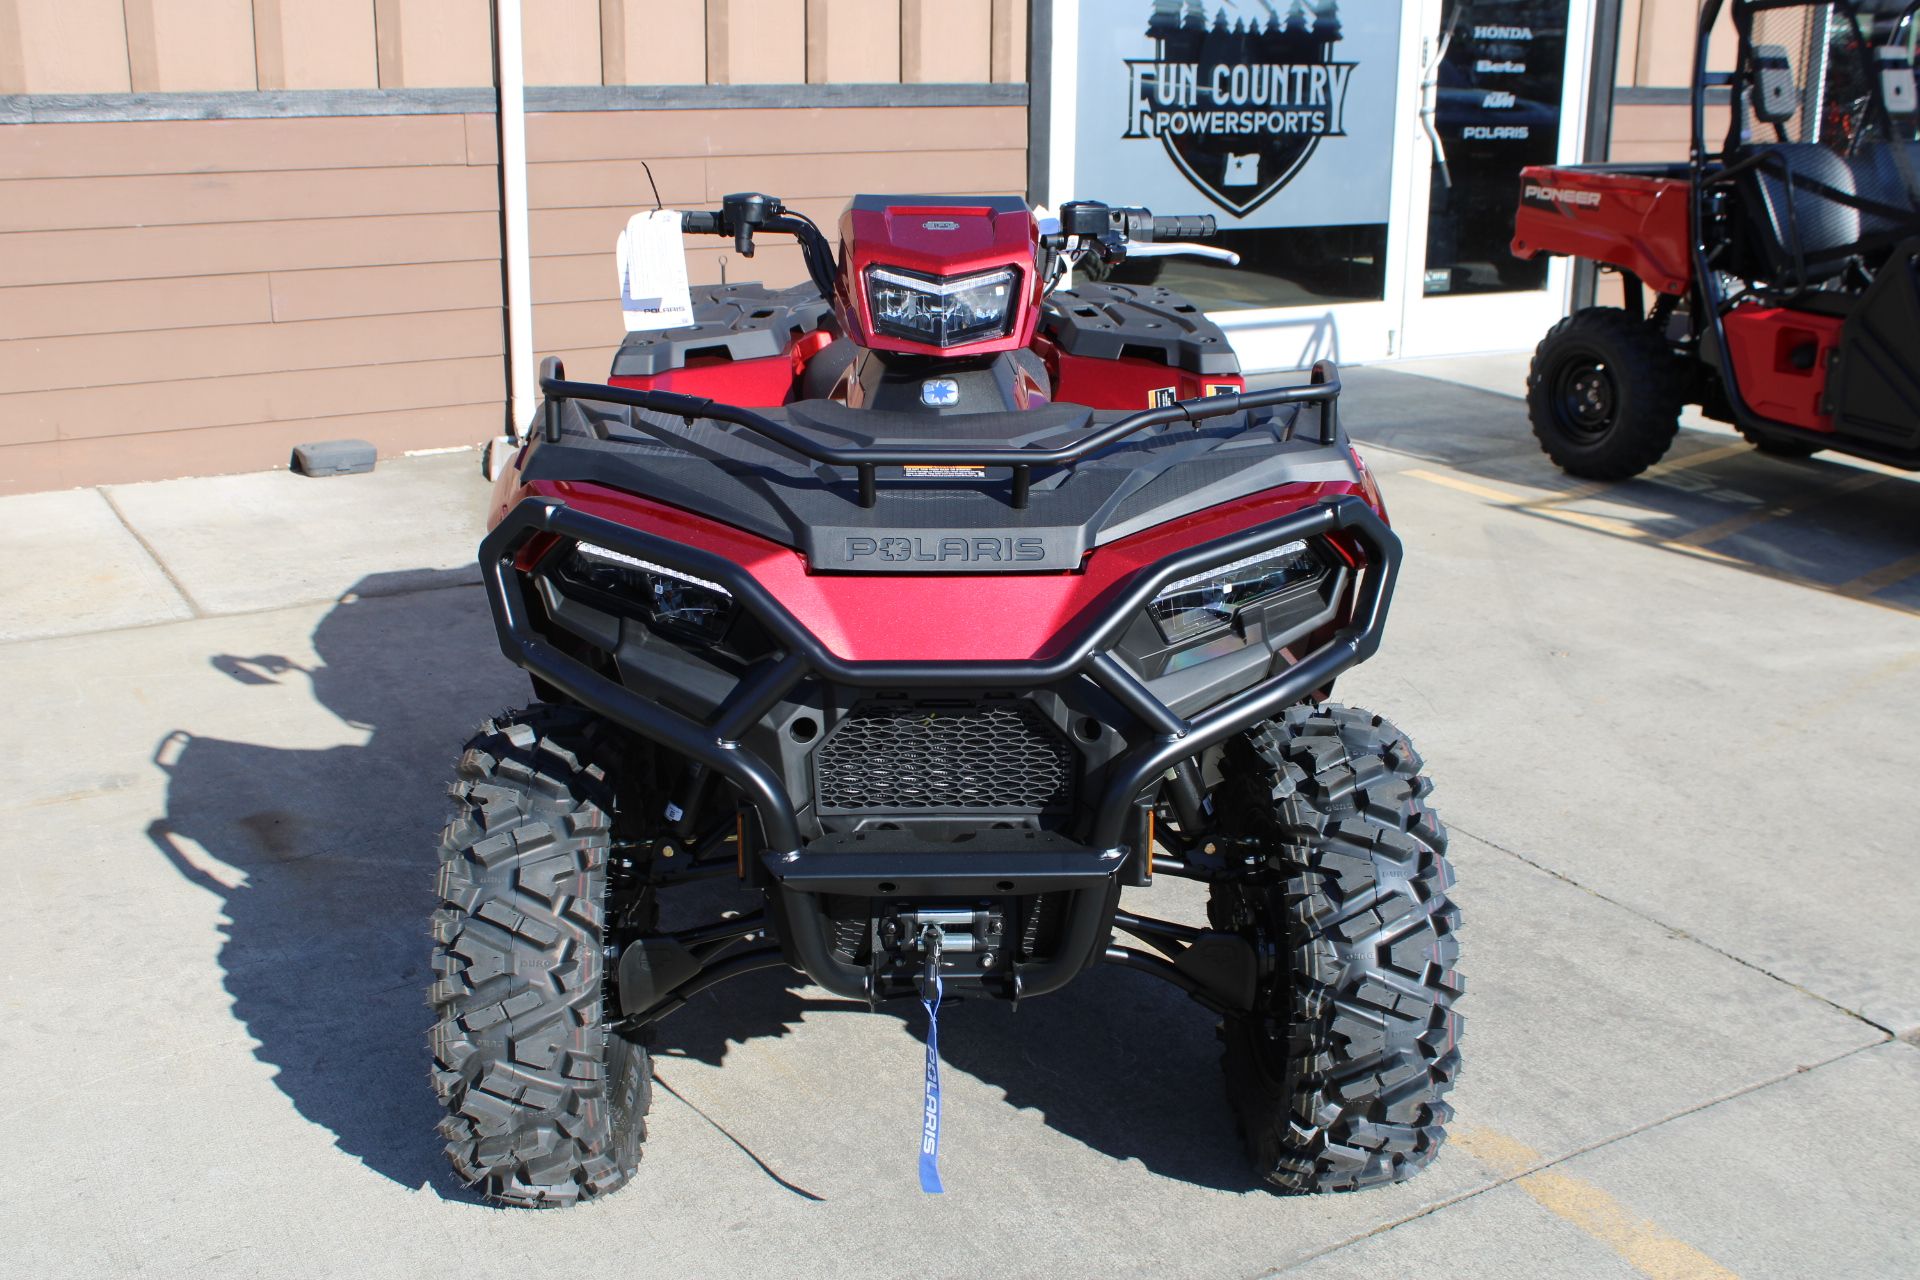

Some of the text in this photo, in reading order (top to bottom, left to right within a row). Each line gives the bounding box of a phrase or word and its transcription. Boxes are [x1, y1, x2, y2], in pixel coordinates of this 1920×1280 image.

[1473, 26, 1533, 40] HONDA
[1476, 60, 1526, 73] Beta
[1129, 62, 1351, 136] FUN COUNTRY
[1482, 91, 1516, 108] KTM
[1156, 111, 1326, 135] POWERSPORTS
[1463, 127, 1529, 139] POLARIS
[1525, 185, 1601, 206] PIONEER
[845, 537, 1046, 562] POLARIS
[923, 1045, 938, 1155] POLARIS
